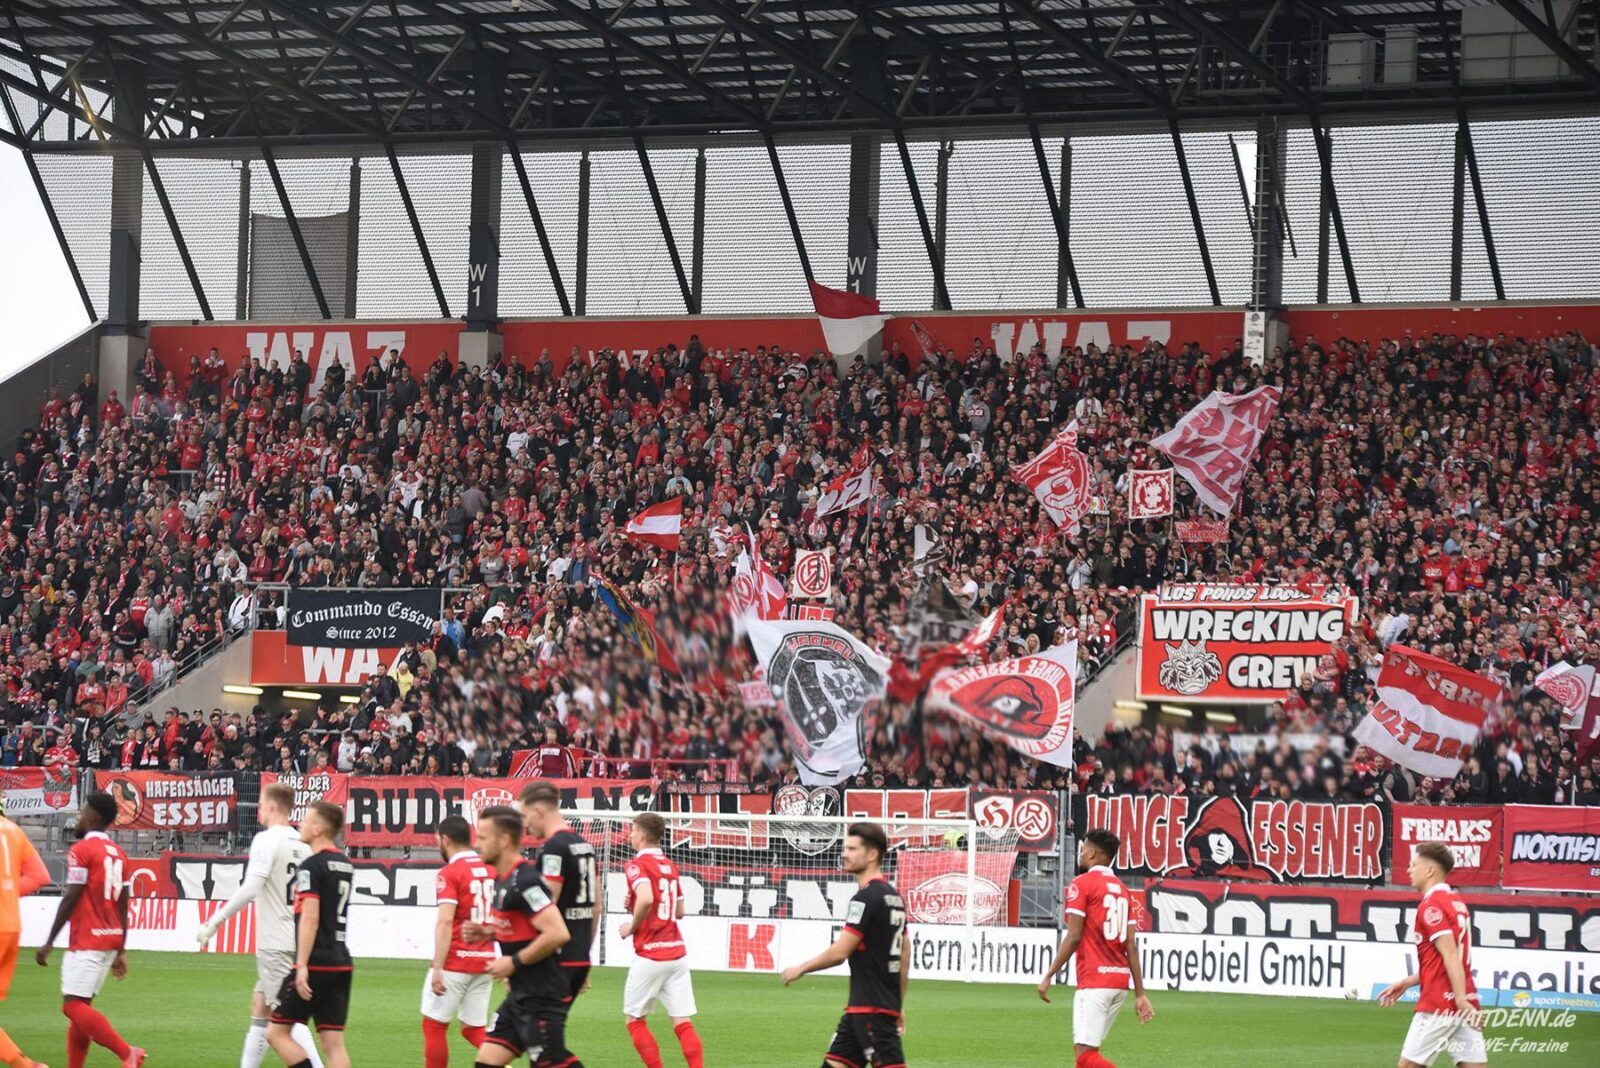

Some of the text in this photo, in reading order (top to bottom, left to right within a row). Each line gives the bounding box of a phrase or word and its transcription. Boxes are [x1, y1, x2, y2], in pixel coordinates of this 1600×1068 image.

[469, 264, 487, 281] W
[472, 286, 480, 306] 1
[291, 600, 433, 630] Commando Essen
[1152, 608, 1345, 642] WRECKING
[326, 626, 397, 639] Since 2012
[145, 776, 234, 798] HAFENSÄNGER
[153, 801, 229, 825] ESSEN
[1250, 801, 1383, 879] ESSENER
[1401, 817, 1493, 842] FREAKS
[658, 877, 678, 922] 31
[1103, 893, 1129, 943] 30
[729, 923, 775, 970] K
[1260, 941, 1346, 988] GmbH
